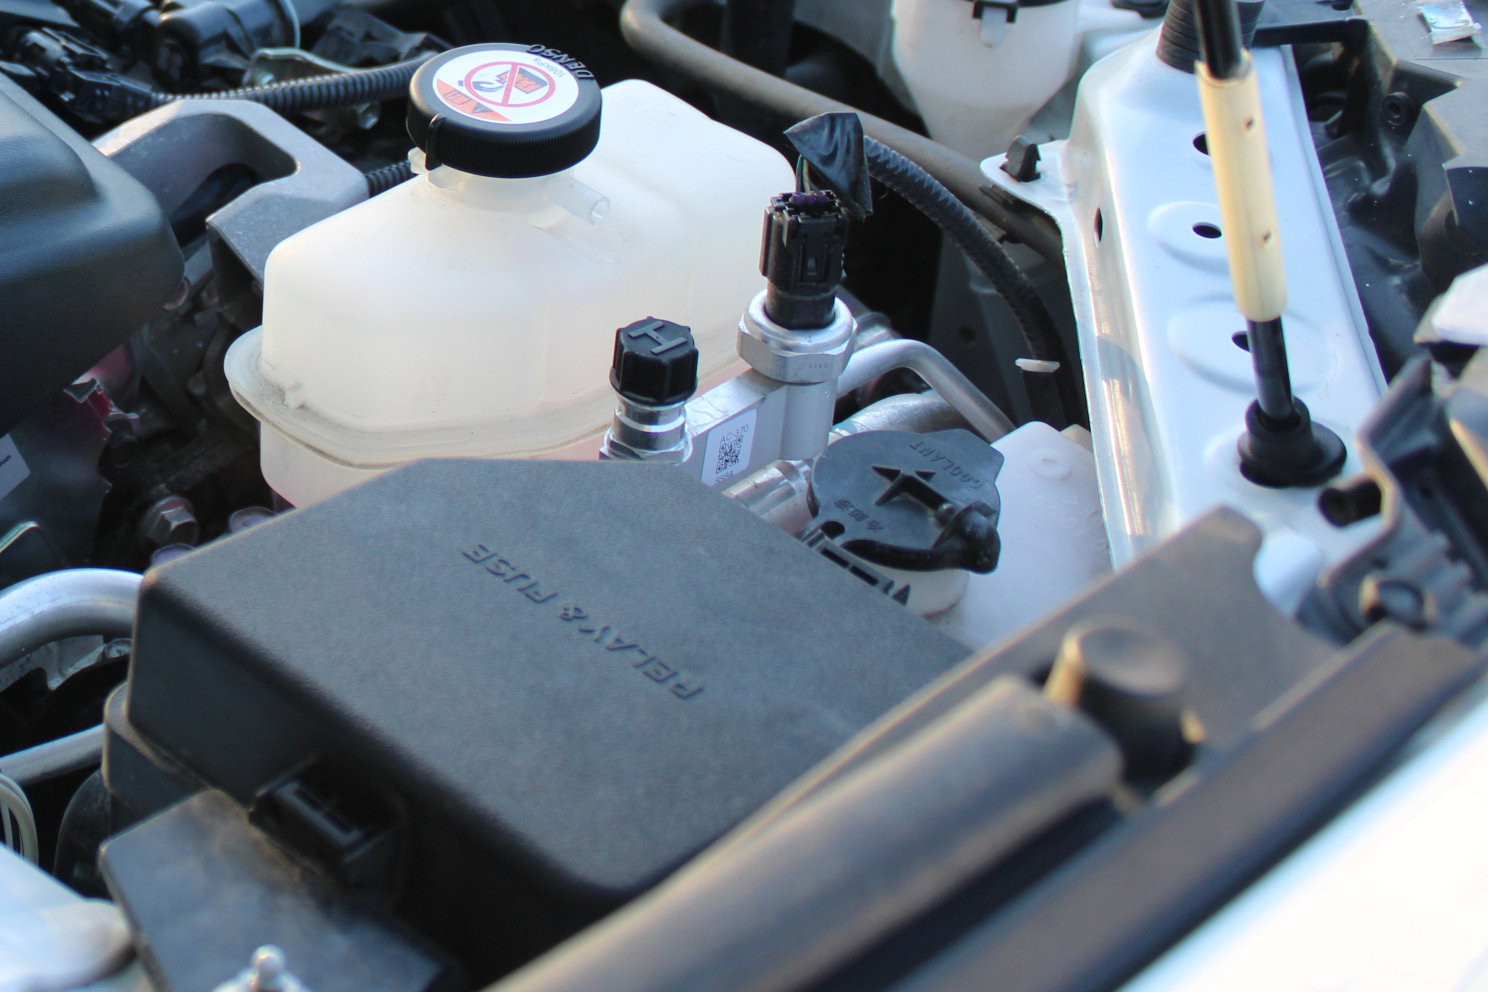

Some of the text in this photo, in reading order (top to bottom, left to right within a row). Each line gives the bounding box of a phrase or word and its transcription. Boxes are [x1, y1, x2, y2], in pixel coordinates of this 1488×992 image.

[528, 44, 594, 80] DENSO
[627, 320, 689, 355] H
[909, 441, 983, 489] COOLANT
[462, 544, 705, 700] RELAY & FUSE
